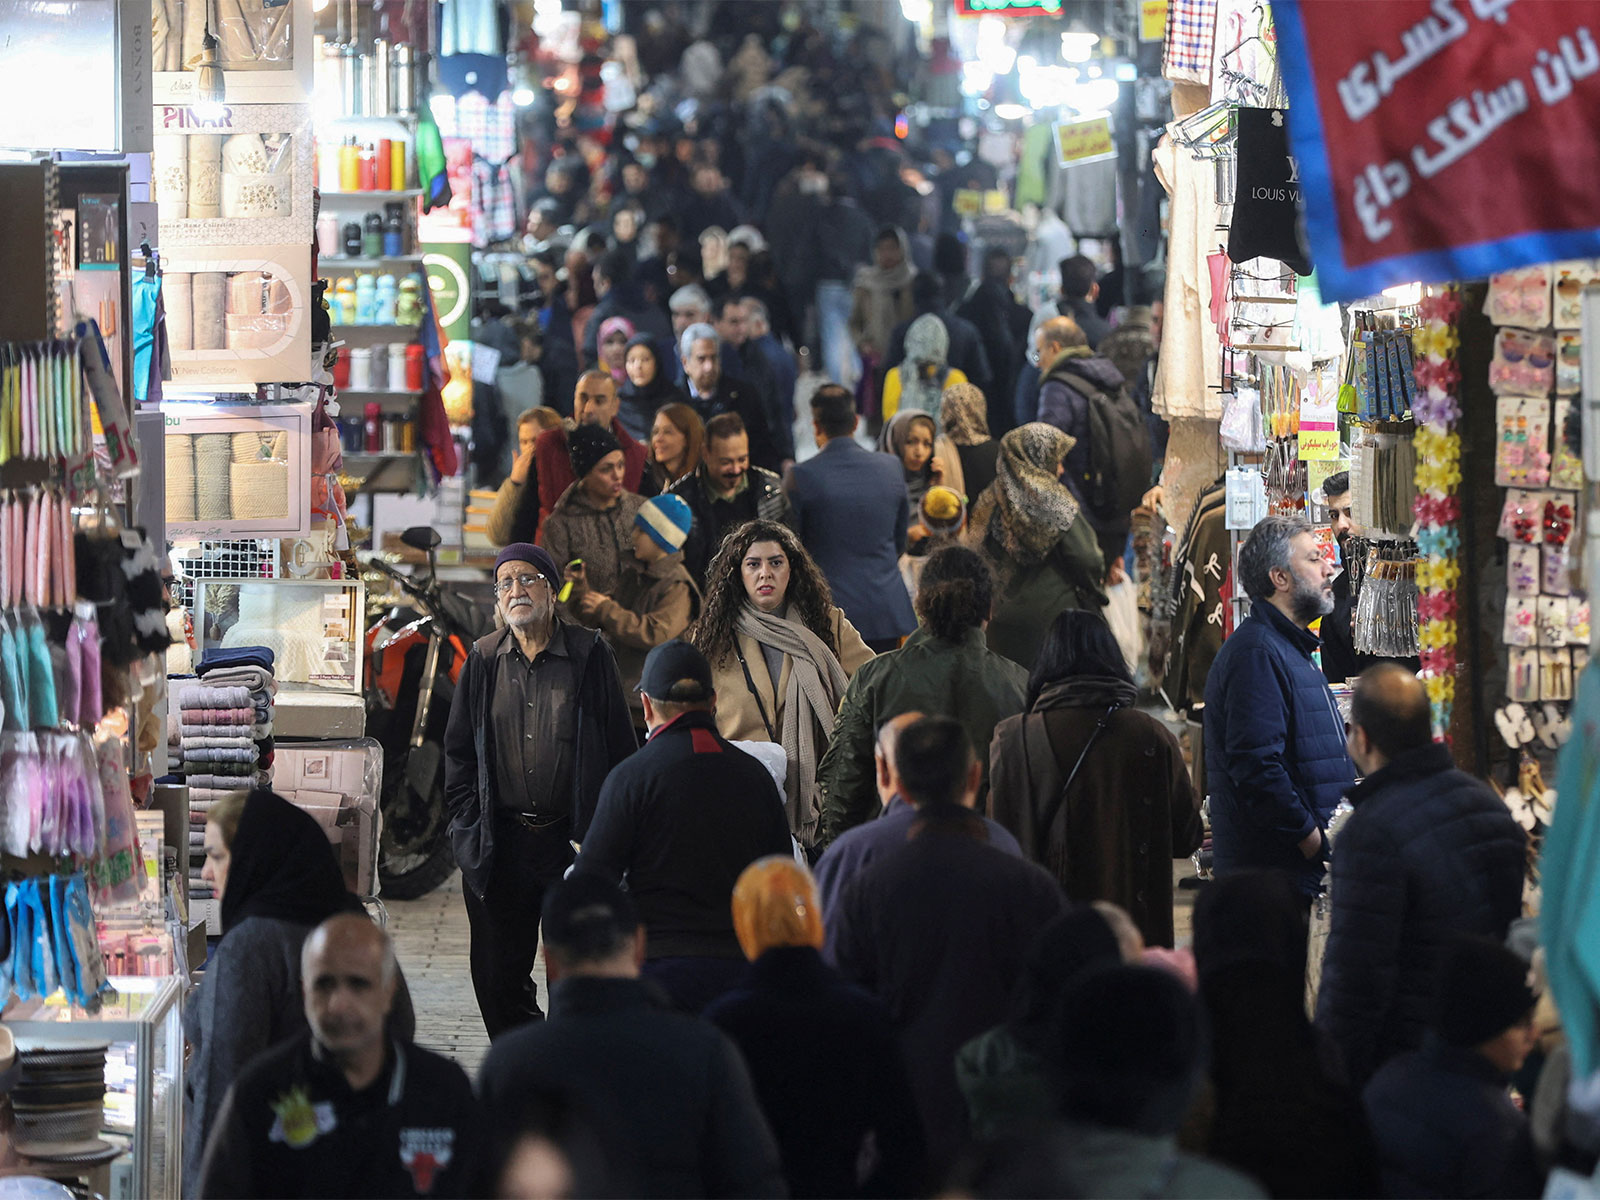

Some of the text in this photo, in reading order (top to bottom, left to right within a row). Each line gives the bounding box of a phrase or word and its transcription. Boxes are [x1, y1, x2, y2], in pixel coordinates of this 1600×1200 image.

[1531, 26, 1600, 106] نان
[1252, 187, 1286, 202] LOUIS
[1354, 160, 1411, 243] داغ
[201, 366, 238, 375] Collection
